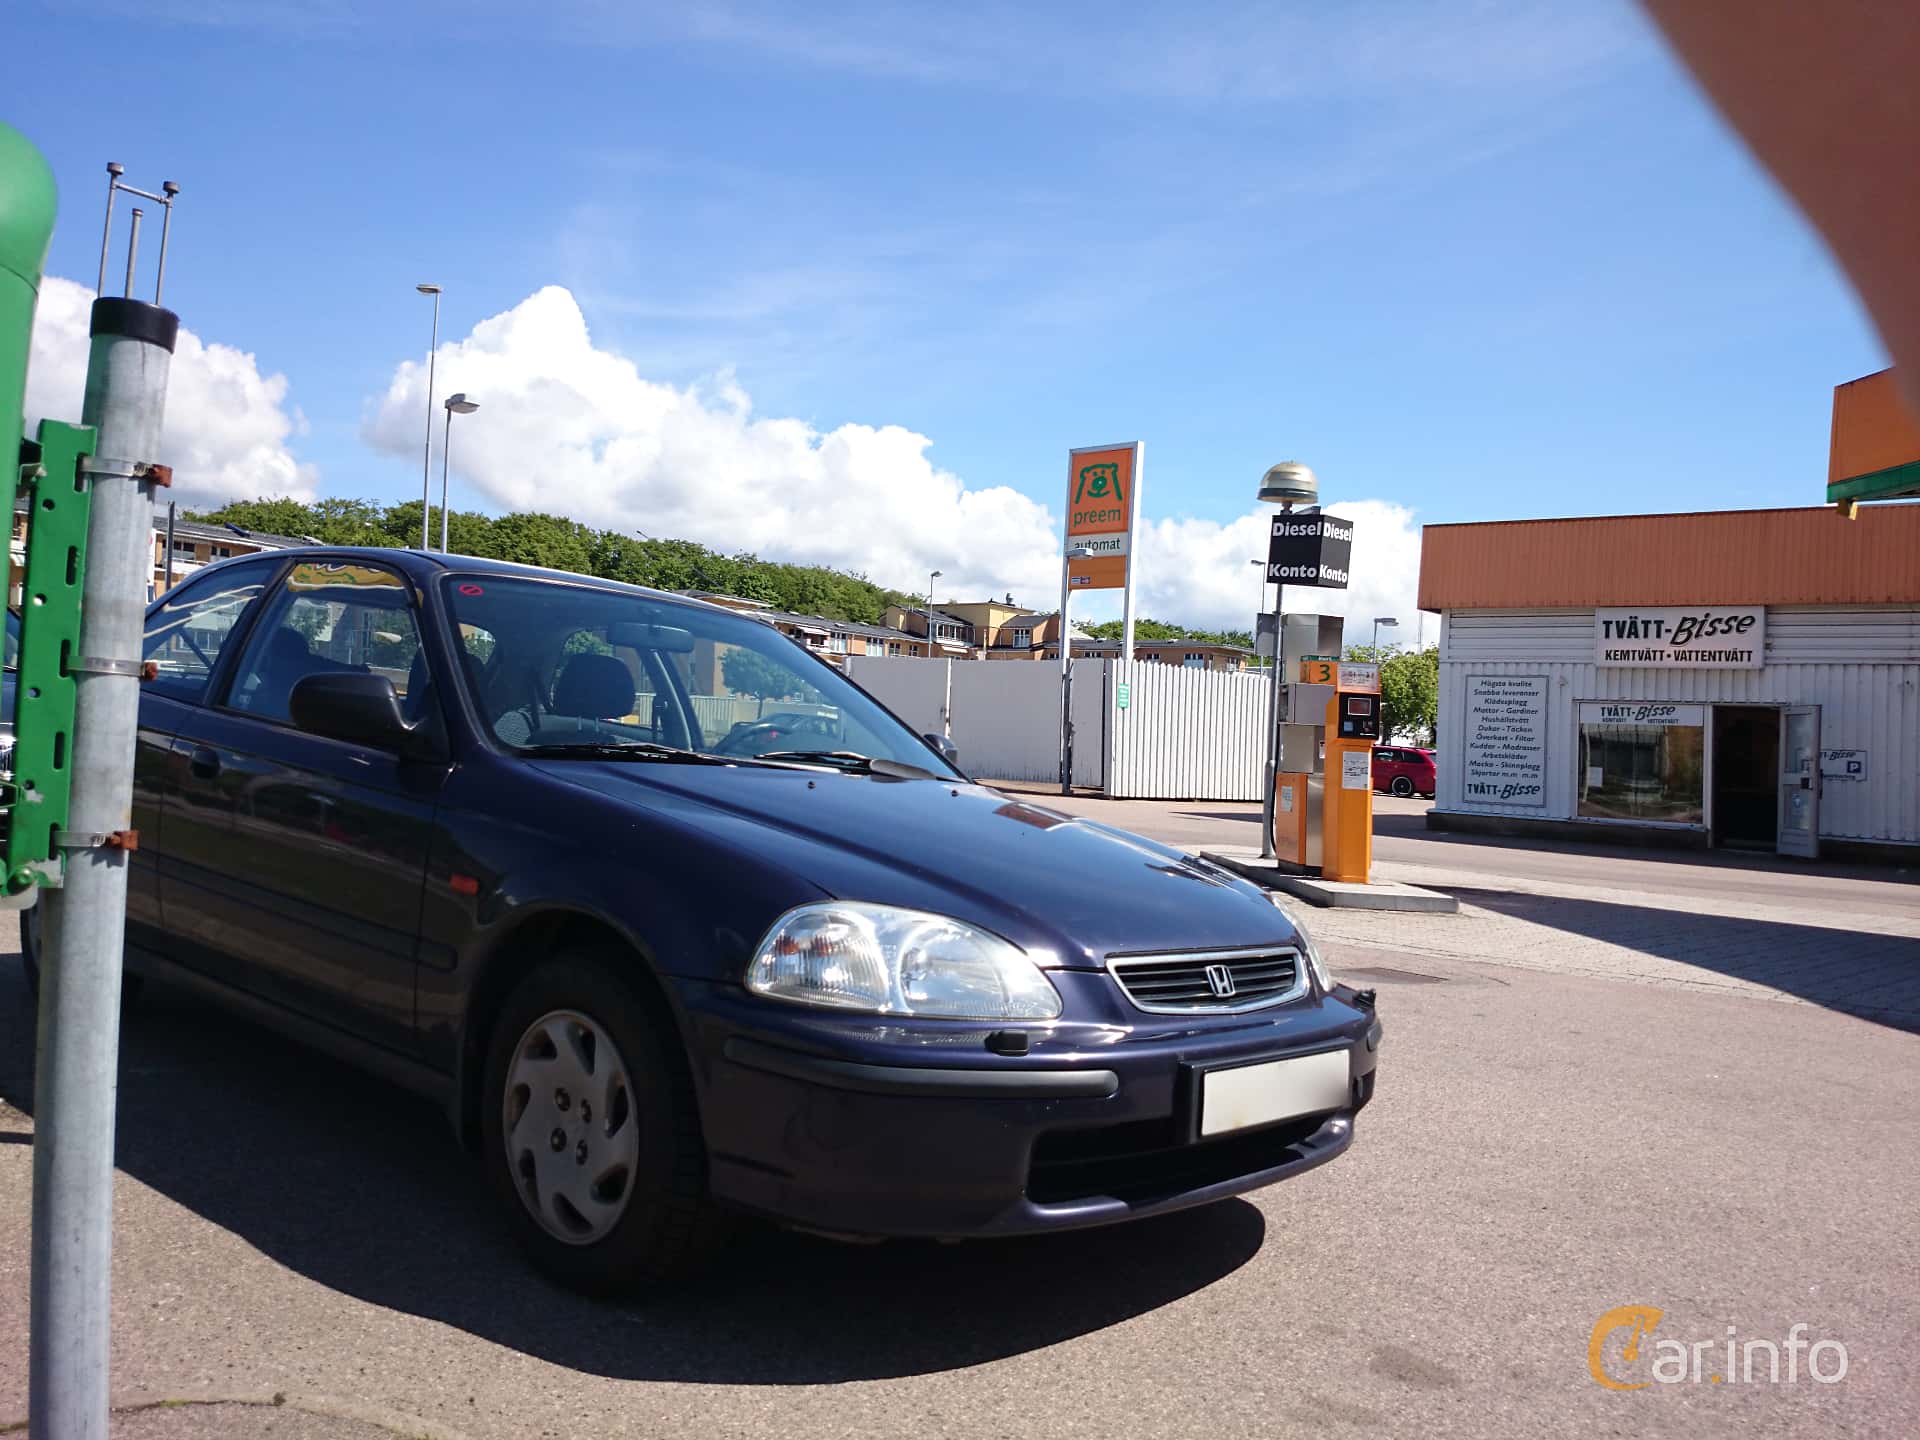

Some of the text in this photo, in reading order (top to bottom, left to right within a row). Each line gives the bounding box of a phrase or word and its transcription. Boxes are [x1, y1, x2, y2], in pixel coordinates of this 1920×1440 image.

[1073, 508, 1121, 528] preem
[1272, 521, 1322, 537] Diesel
[1323, 522, 1353, 542] Diesel
[1269, 563, 1317, 578] Konto
[1320, 564, 1348, 583] Konto
[1602, 613, 1756, 647] TVÄTT-Bisse
[1605, 648, 1753, 663] KEMTVÄTT VATTENTVÄTT
[1318, 664, 1331, 682] 3
[1601, 705, 1676, 721] TVÄTT-Bisse
[1467, 782, 1541, 799] TVÄTT-Bisse
